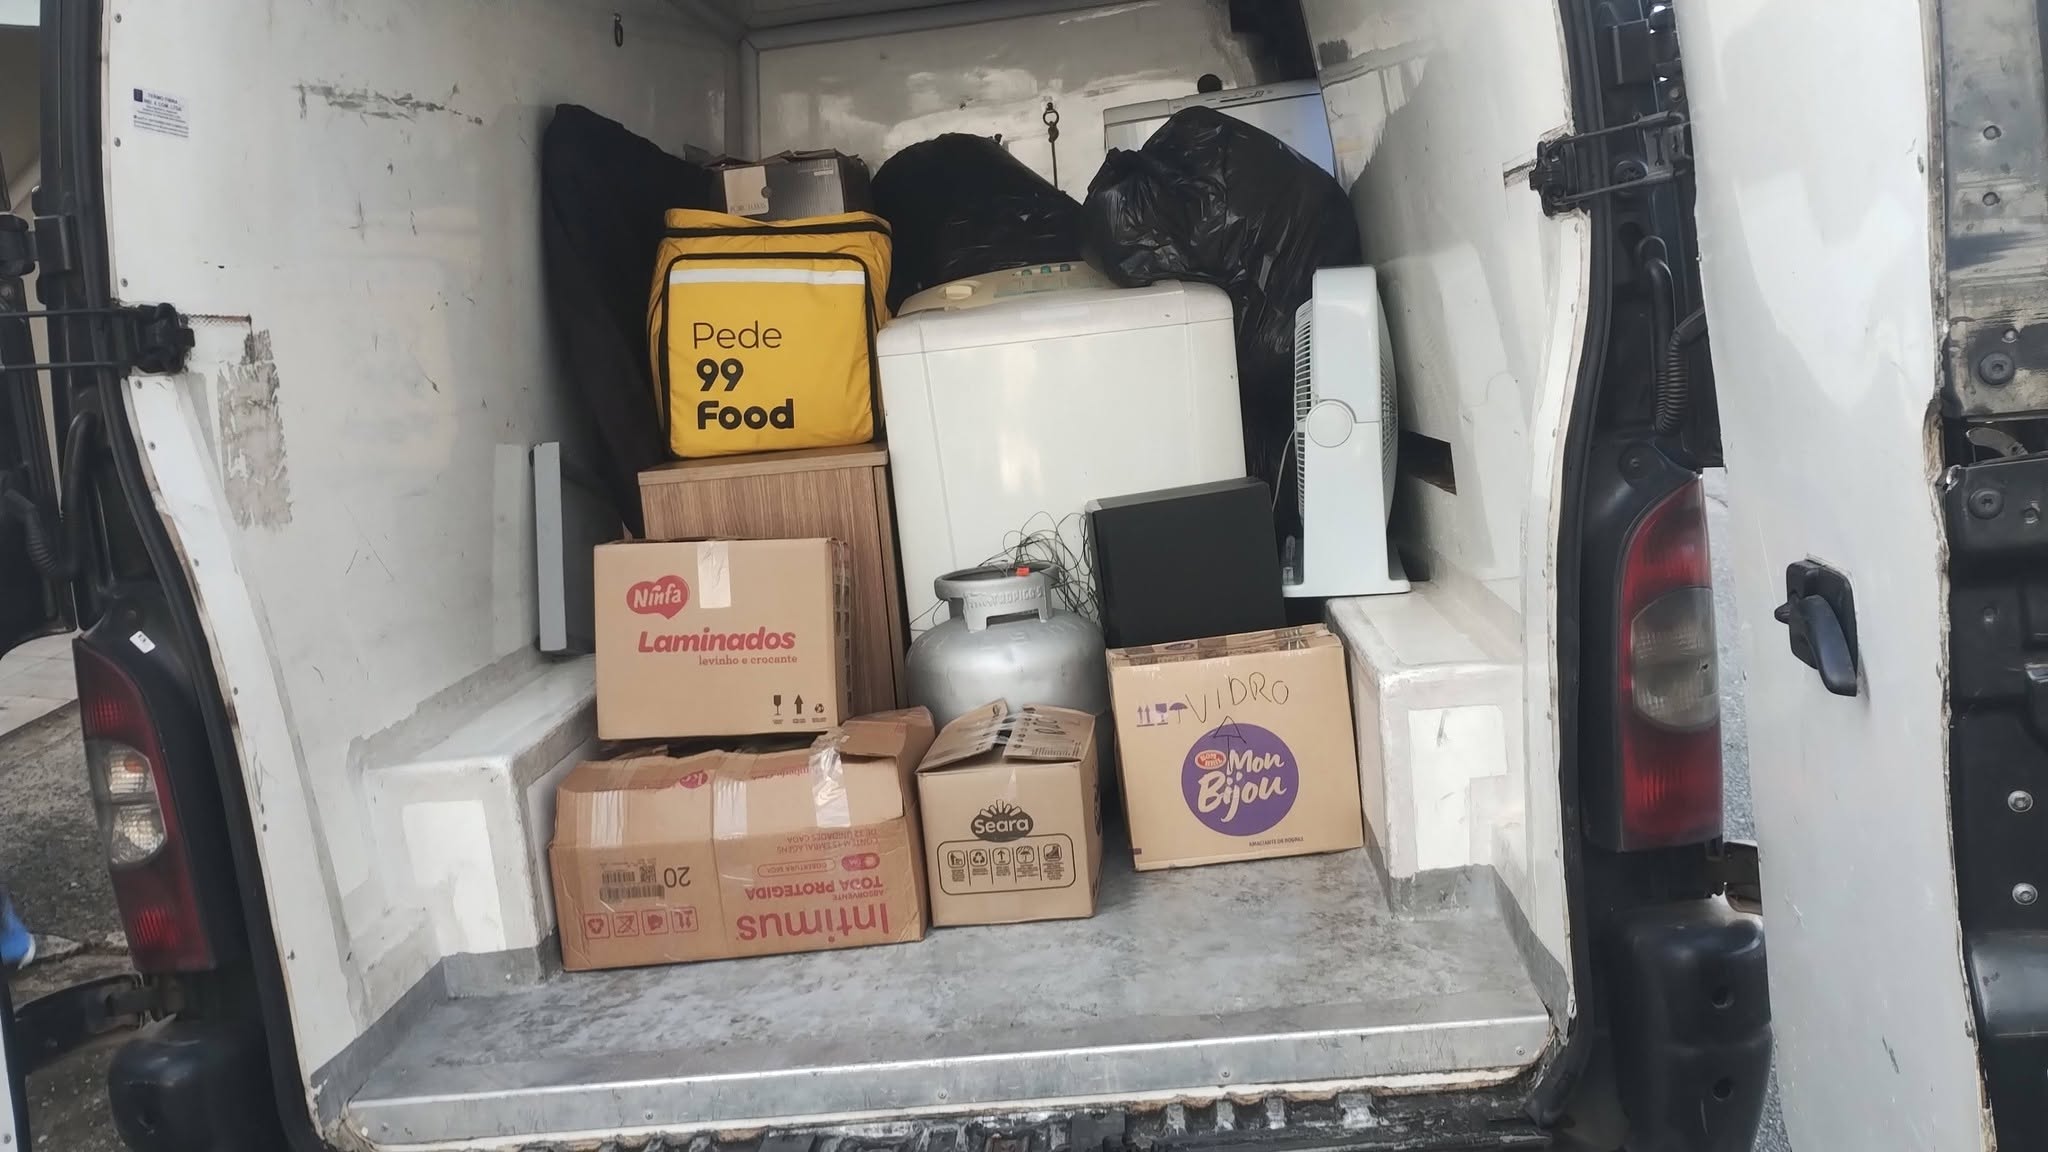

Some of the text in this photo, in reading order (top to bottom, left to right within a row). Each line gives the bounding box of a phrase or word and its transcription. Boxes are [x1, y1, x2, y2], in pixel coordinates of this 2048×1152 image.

[693, 320, 782, 349] Pede
[696, 358, 744, 391] 99
[697, 398, 795, 430] Food
[633, 583, 682, 608] Ninfa
[638, 626, 796, 653] Laminados
[699, 654, 798, 665] levinho e crocante
[1185, 672, 1289, 724] VIDRO
[1227, 749, 1284, 775] Mon
[1198, 770, 1287, 822] Bijou
[974, 818, 1029, 834] Seara
[664, 866, 691, 888] 20
[745, 876, 883, 900] TODA PROTEGIDA
[832, 890, 884, 901] ABSORVENTE
[736, 903, 889, 943] Intimus
